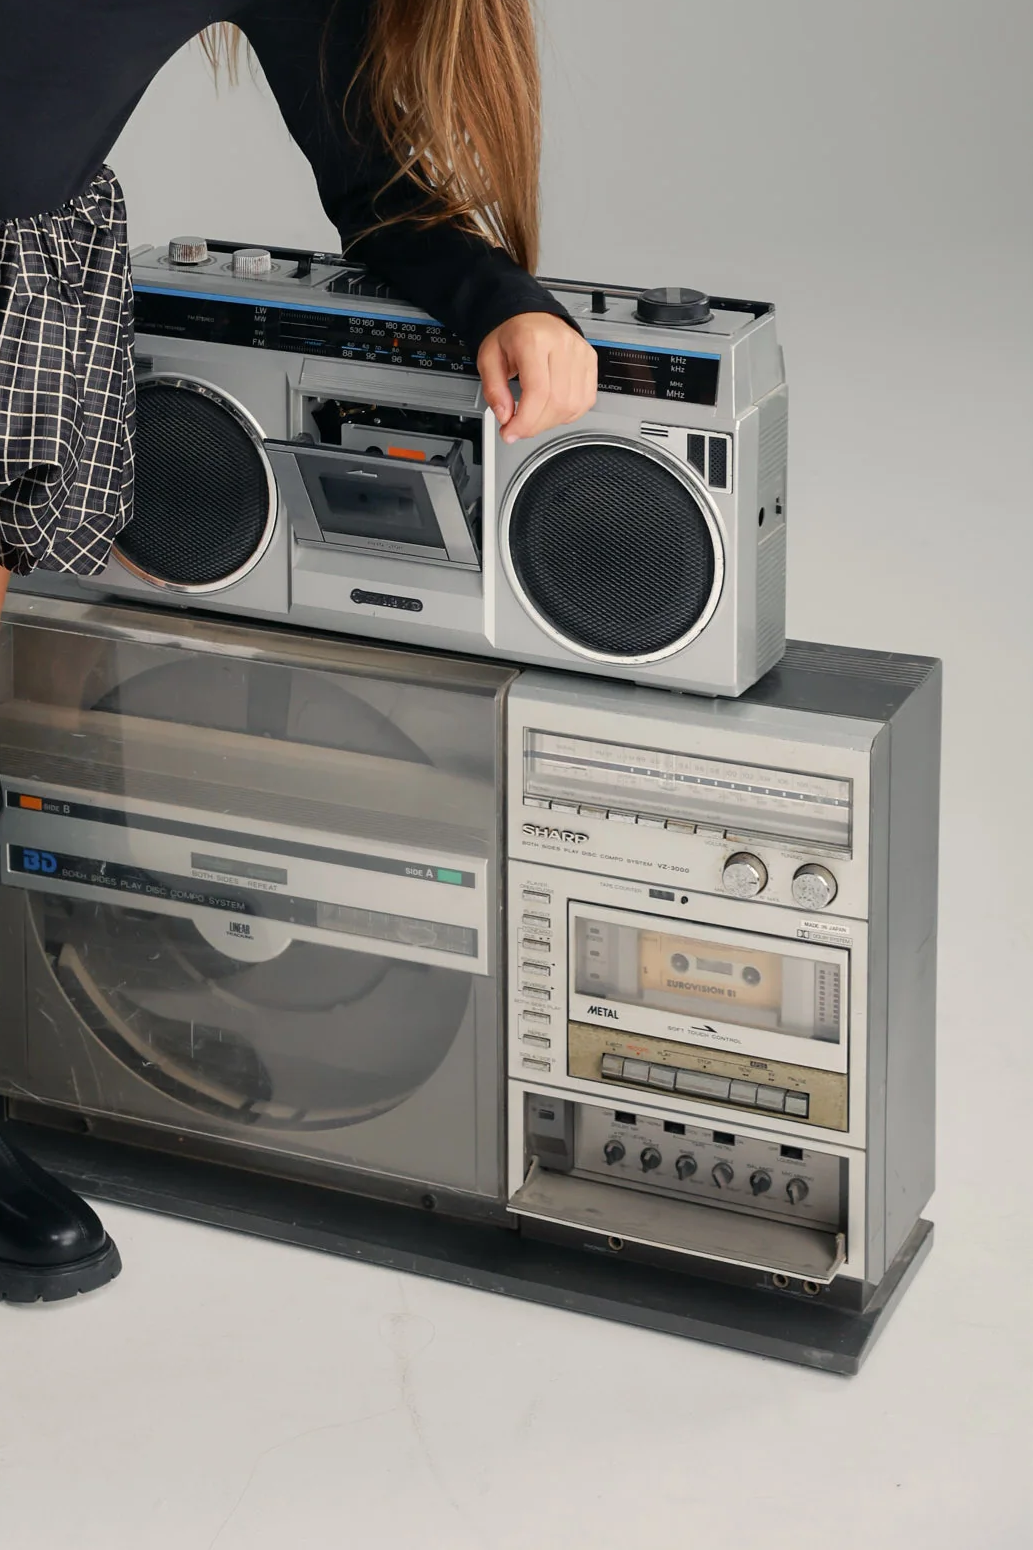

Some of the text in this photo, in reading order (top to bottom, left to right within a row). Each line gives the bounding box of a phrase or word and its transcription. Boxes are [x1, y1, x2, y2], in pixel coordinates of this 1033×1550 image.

[254, 306, 267, 314] LW
[253, 315, 267, 323] MW
[348, 317, 441, 335] 150 160 180 200 230
[349, 326, 447, 344] 530 600 700 800 1000
[252, 338, 265, 347] FM
[342, 349, 464, 371] 88 92 96 100 104
[670, 356, 687, 365] kHz
[670, 365, 686, 373] kHz
[669, 380, 684, 388] MHz
[666, 389, 685, 399] MHz
[63, 805, 70, 814] B
[522, 823, 590, 844] SHARP
[521, 840, 690, 874] BOTH SIDES PLAY DISC COMPO SYSTEM VZ-3000
[405, 867, 434, 878] SIDE A
[192, 869, 278, 891] BOTH SIDES REPEAT
[91, 874, 117, 886] SIDES
[120, 880, 142, 890] PLAY
[146, 884, 166, 895] DISC
[169, 889, 205, 903] COMPO
[208, 896, 246, 910] SYSTEM
[614, 883, 643, 893] COUNTER
[229, 921, 251, 935] LINEAR
[804, 921, 819, 930] MADE
[829, 925, 847, 933] JAPAN
[225, 930, 255, 941] TRACKING
[829, 935, 851, 944] SYSTEM
[666, 978, 725, 998] EUROVISION
[587, 1004, 619, 1020] METAL
[667, 1024, 742, 1045] SOFT TOUCH CONTROL
